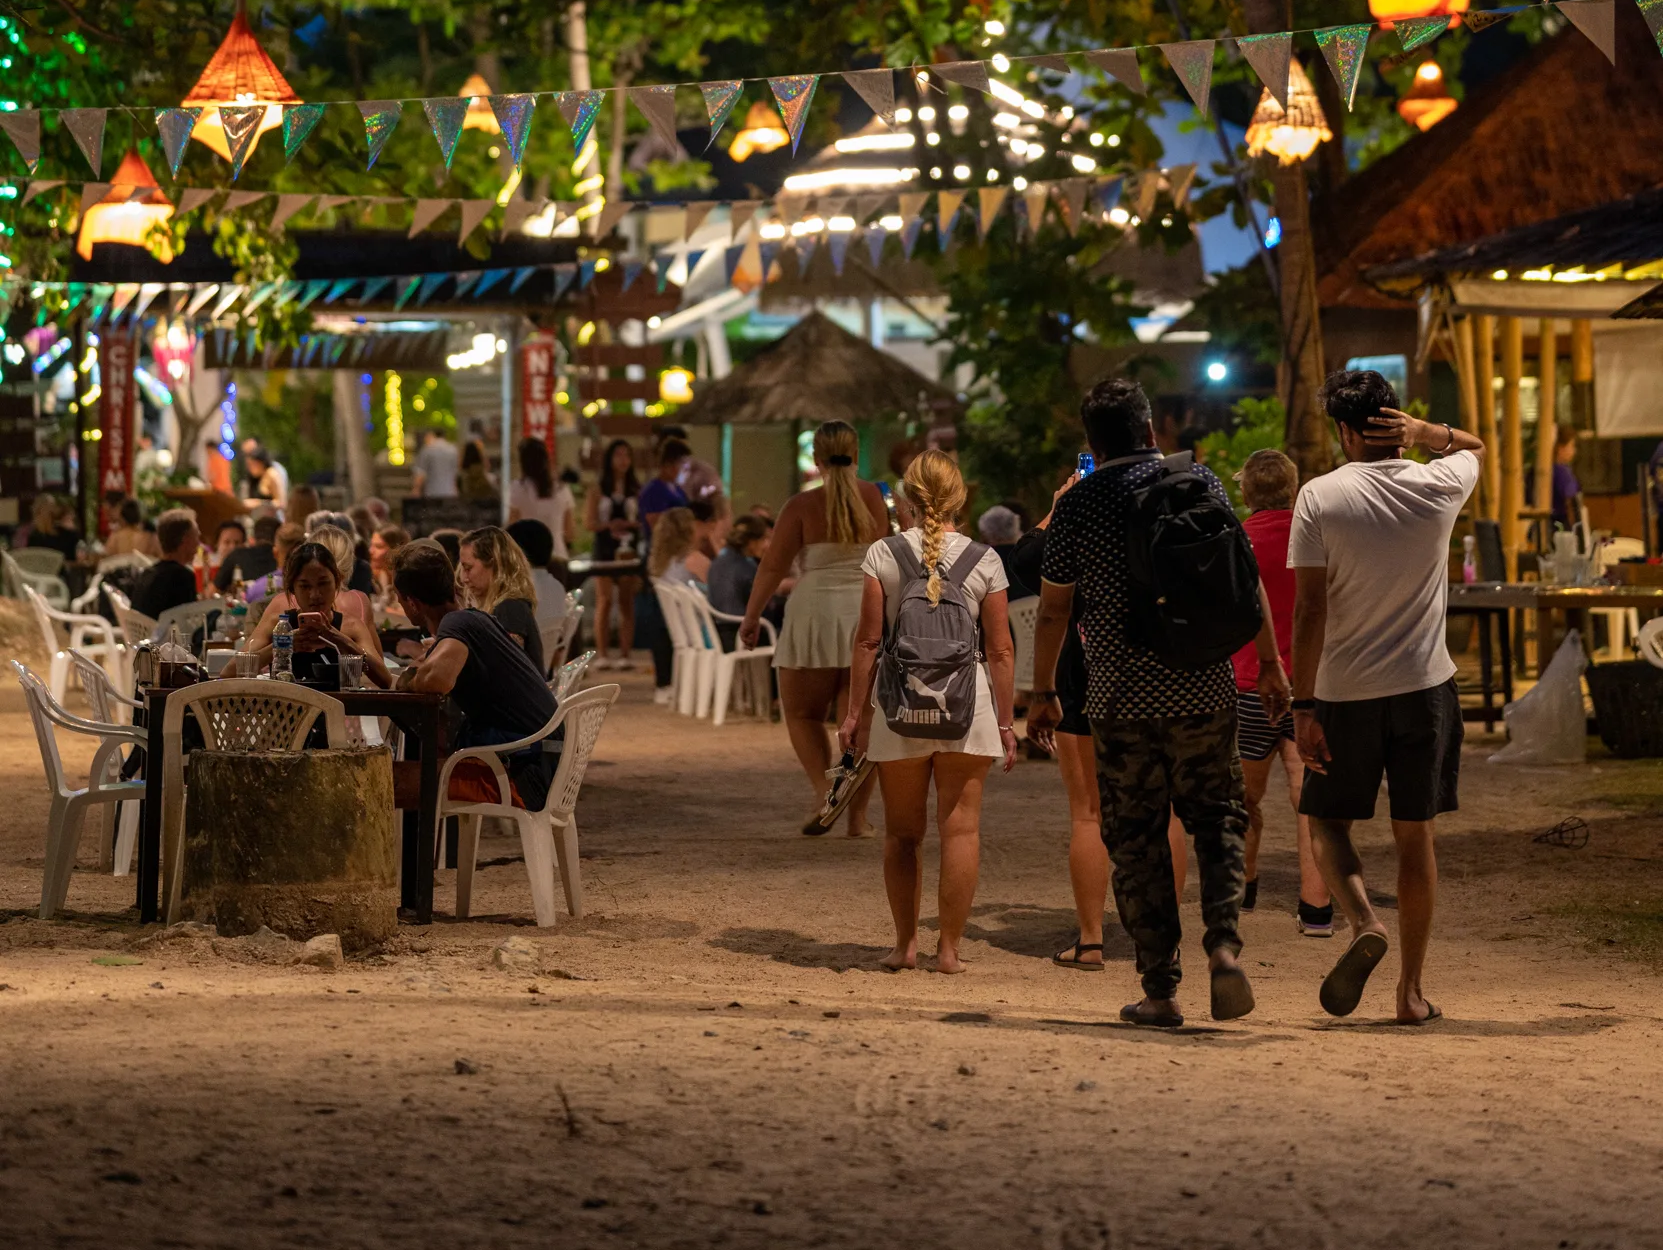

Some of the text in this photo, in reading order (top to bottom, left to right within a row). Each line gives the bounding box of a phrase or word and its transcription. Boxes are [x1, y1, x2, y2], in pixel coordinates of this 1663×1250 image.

[105, 345, 127, 491] CHRISTM
[528, 351, 549, 425] NEW
[896, 706, 941, 724] PUMA
